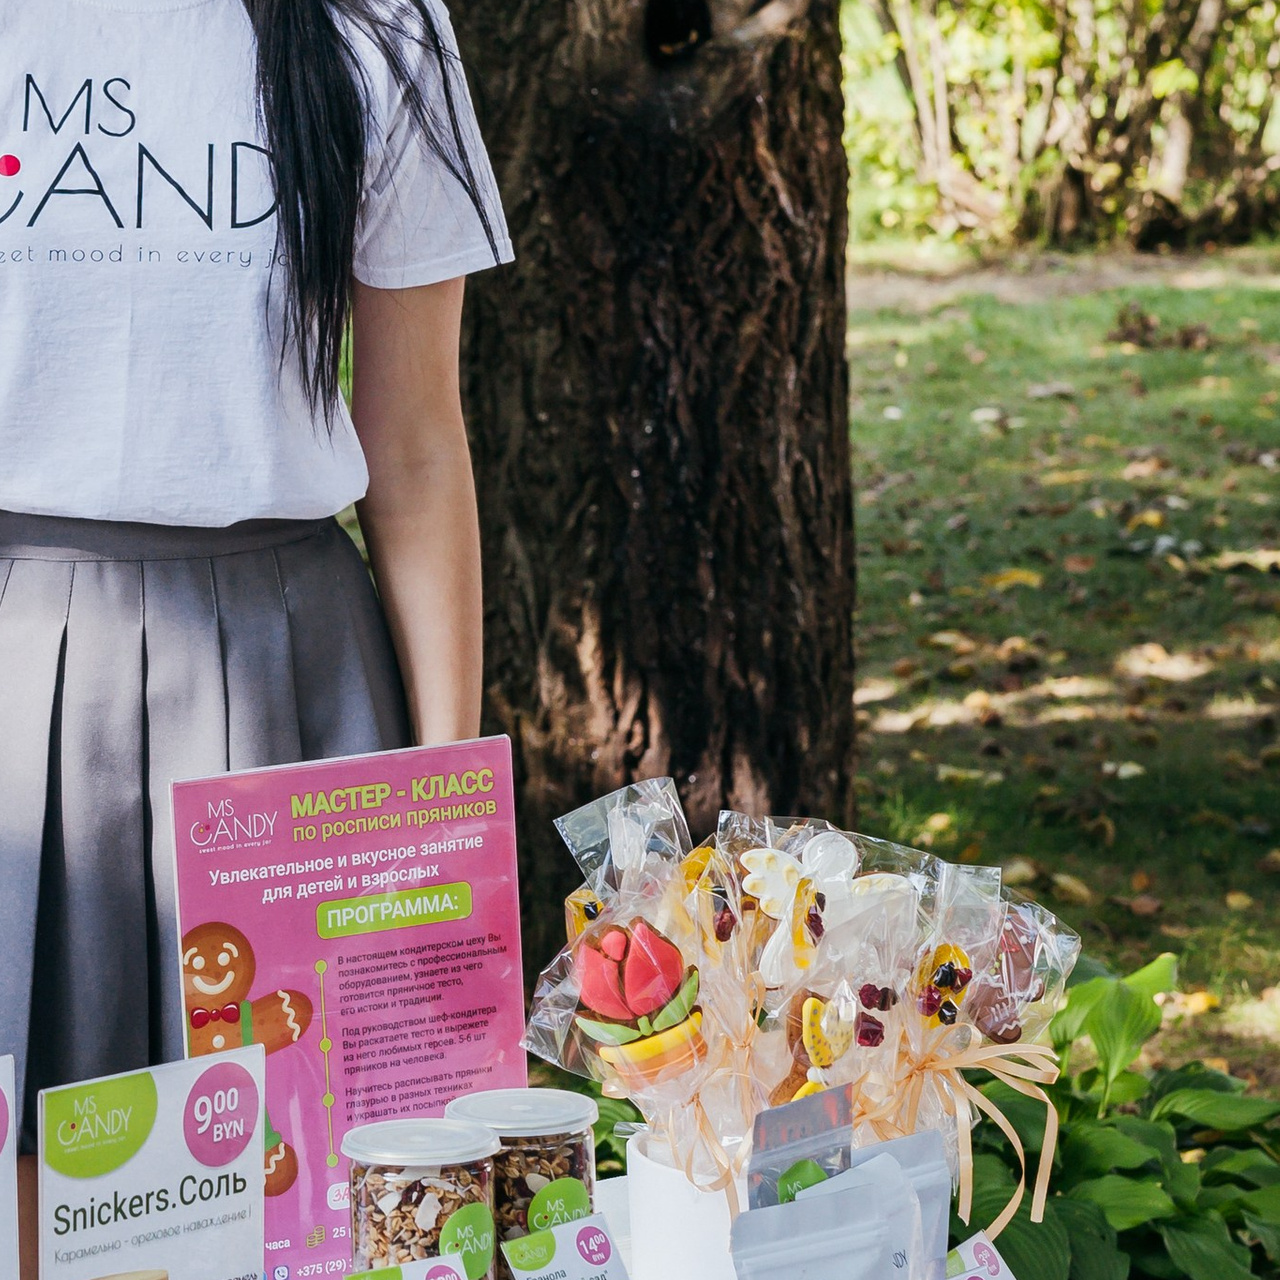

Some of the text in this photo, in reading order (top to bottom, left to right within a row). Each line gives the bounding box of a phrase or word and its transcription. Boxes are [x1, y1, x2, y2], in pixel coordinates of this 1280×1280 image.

[23, 73, 136, 137] MS
[49, 245, 123, 262] mood
[139, 247, 161, 263] in
[177, 249, 253, 268] every
[290, 768, 494, 819] МАСТЕР КЛАСС
[208, 798, 235, 819] MS
[293, 800, 497, 842] по росписи пряников
[190, 811, 278, 846] CANDY
[209, 836, 483, 886] Увлекательное и вкусное занятие
[262, 865, 439, 904] для детей и взрослых
[327, 894, 458, 928] ПРОГРАММА:
[338, 946, 507, 978] познакомитесь профессиональным
[346, 936, 486, 964] настоящем кондитерском цеху
[414, 967, 449, 981] узнаете
[339, 982, 435, 1003] готовится пряничное
[357, 993, 444, 1013] истоки традиции.
[342, 1005, 497, 1037] Под руководством шеф-кондитера
[358, 1019, 489, 1048] раскатаете тесто вырежете
[378, 1044, 422, 1057] любимых
[344, 1062, 388, 1076] пряников
[345, 1065, 493, 1096] Научитесь расписывать пряники
[346, 1082, 473, 1109] глазурью разных техниках
[213, 1118, 244, 1144] BYN
[53, 1172, 248, 1236] Snickers.Соль
[54, 1237, 121, 1265] Карамельно
[130, 1223, 181, 1249] ореховое
[265, 1227, 346, 1251] часа 25
[297, 1258, 347, 1277] +375 (29)
